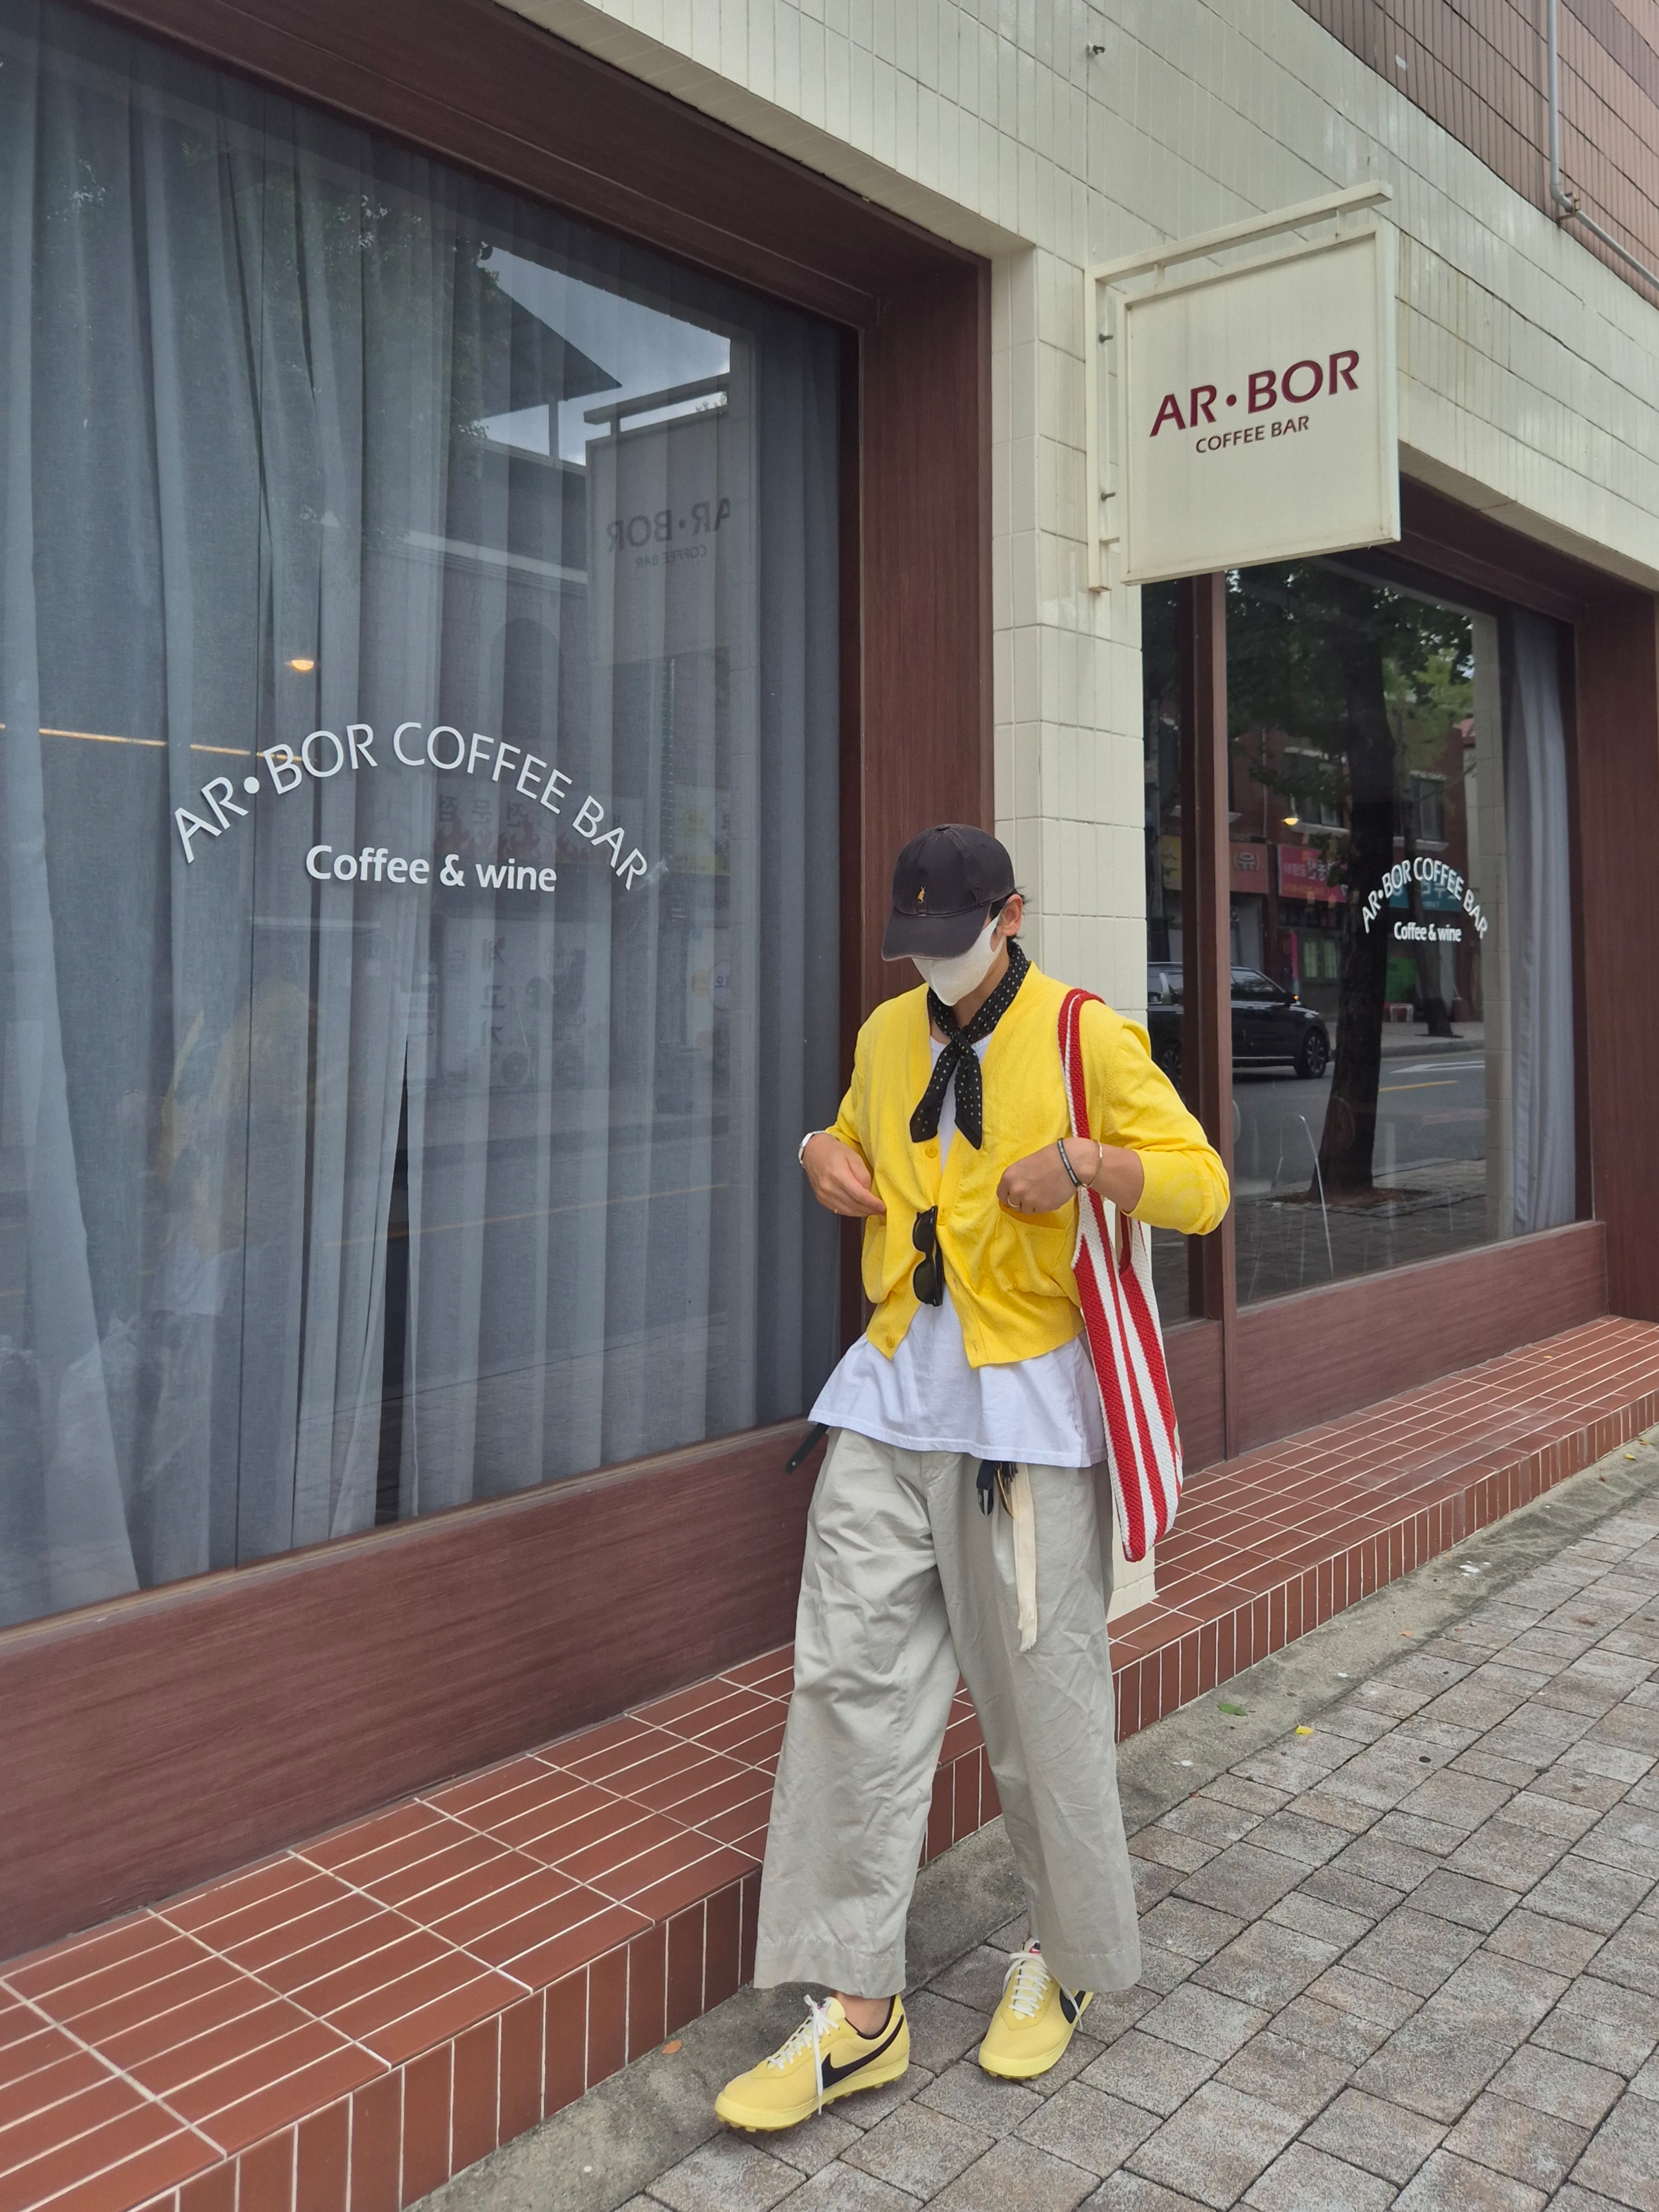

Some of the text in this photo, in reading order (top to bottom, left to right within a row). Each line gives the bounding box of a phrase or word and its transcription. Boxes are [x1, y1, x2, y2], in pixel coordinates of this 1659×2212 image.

[1195, 416, 1310, 454] COFFEE BAR
[393, 721, 572, 814] COFFEE
[572, 795, 647, 890] BAR
[306, 845, 557, 892] Coffee & wine
[1412, 856, 1465, 901] COFFEE
[1463, 888, 1489, 939] BAR
[1393, 921, 1462, 942] Coffee & wine
